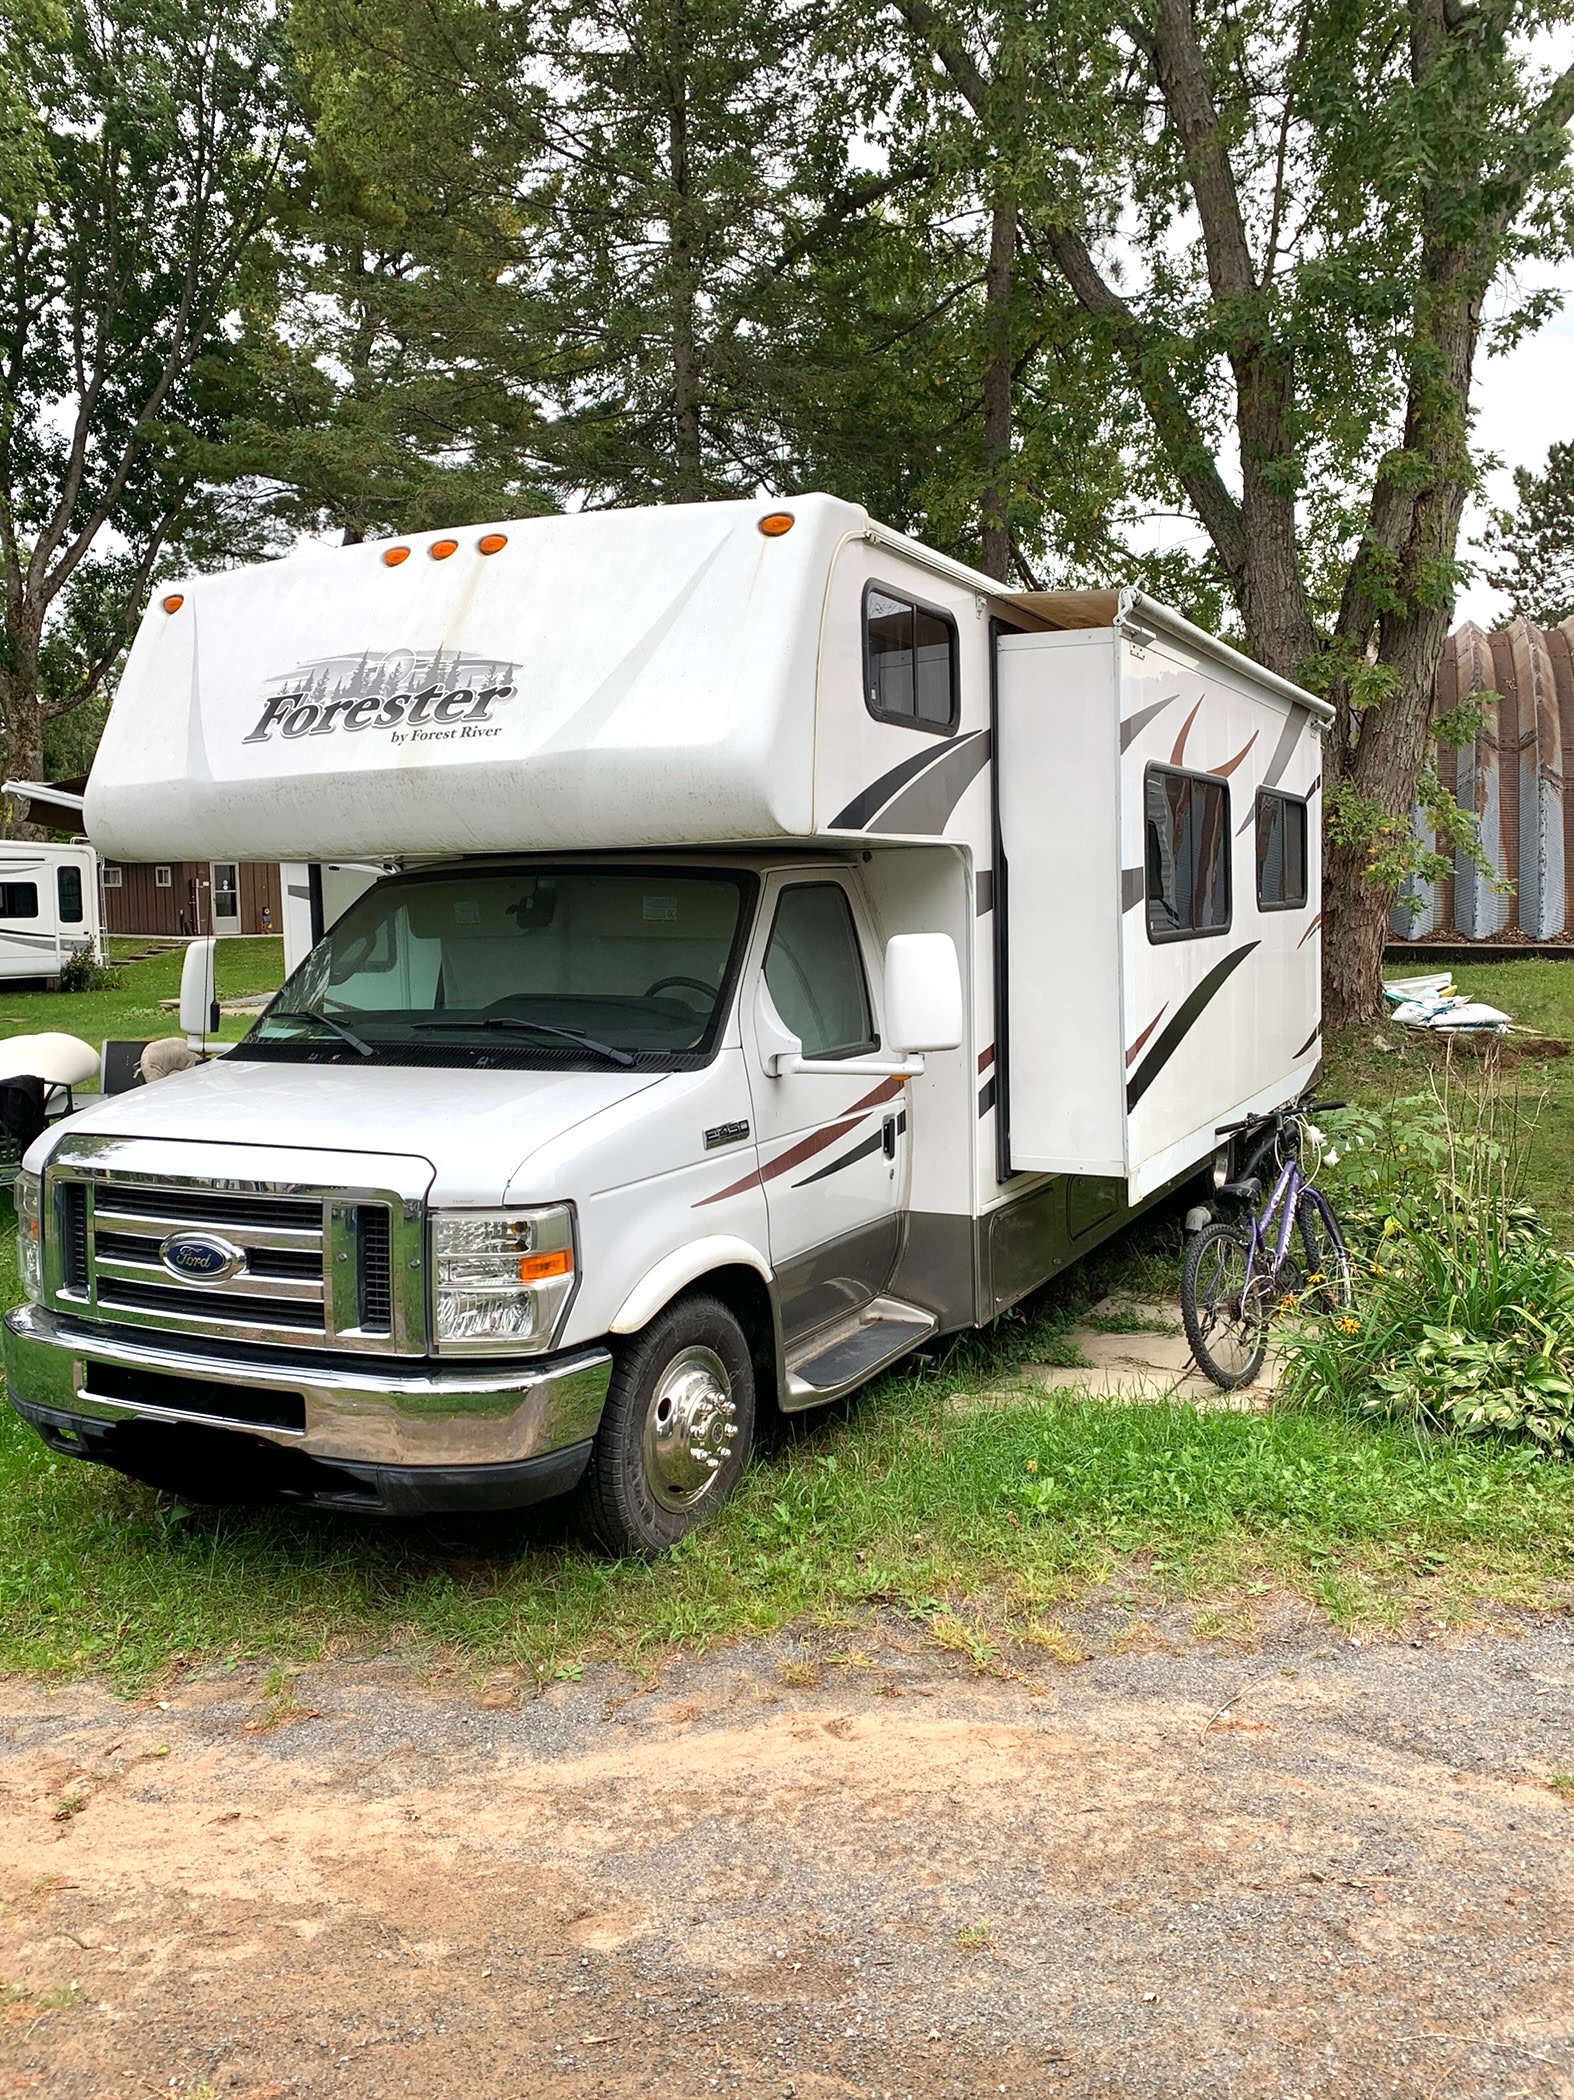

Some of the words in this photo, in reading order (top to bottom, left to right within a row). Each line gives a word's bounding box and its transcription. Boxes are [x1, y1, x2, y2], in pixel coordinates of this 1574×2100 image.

[243, 684, 517, 743] Forester
[391, 731, 408, 746] by
[410, 729, 457, 742] Forest
[459, 726, 502, 738] River
[176, 1246, 212, 1268] Ford
